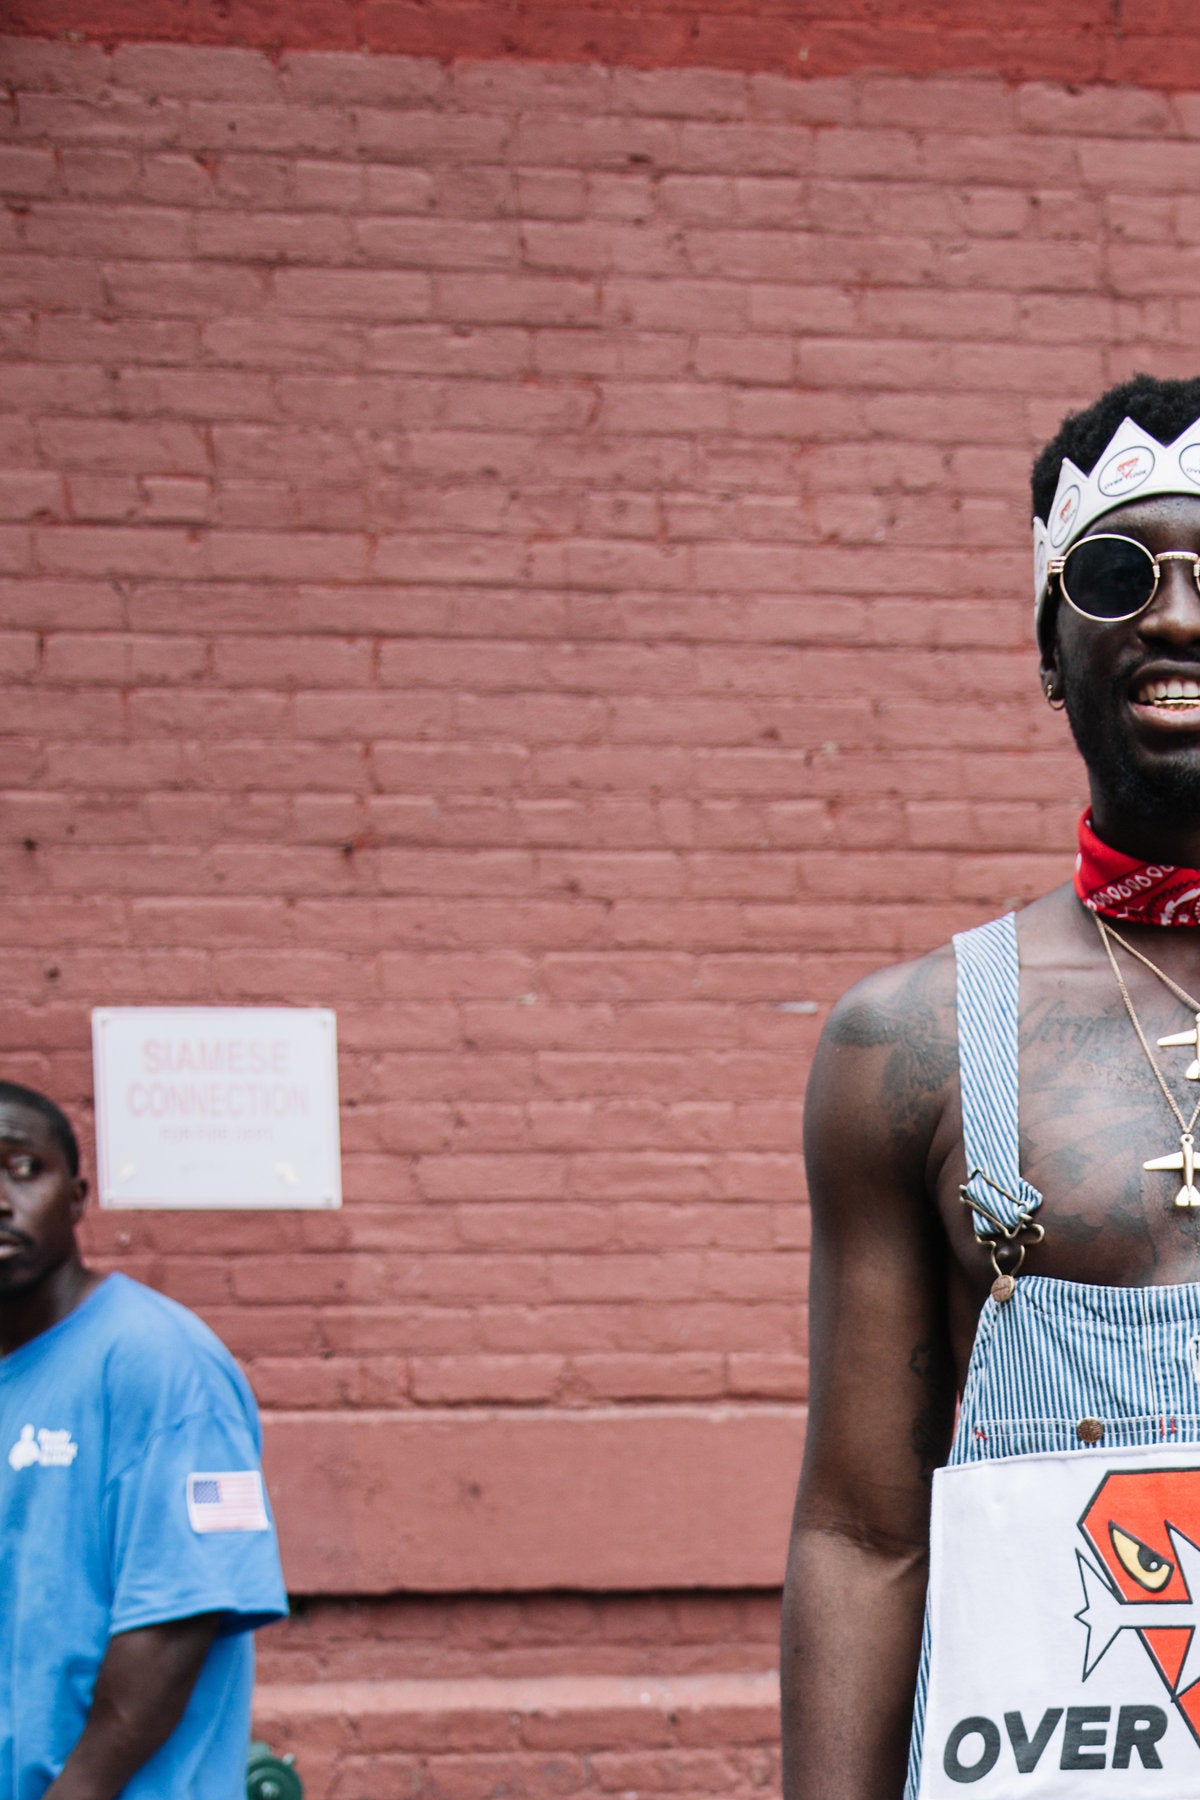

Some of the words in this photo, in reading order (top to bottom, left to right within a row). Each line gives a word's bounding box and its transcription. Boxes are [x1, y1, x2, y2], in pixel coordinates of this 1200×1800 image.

[142, 1038, 291, 1075] SIAMESE
[127, 1080, 311, 1119] CONNECTION
[943, 1704, 1169, 1784] OVER
